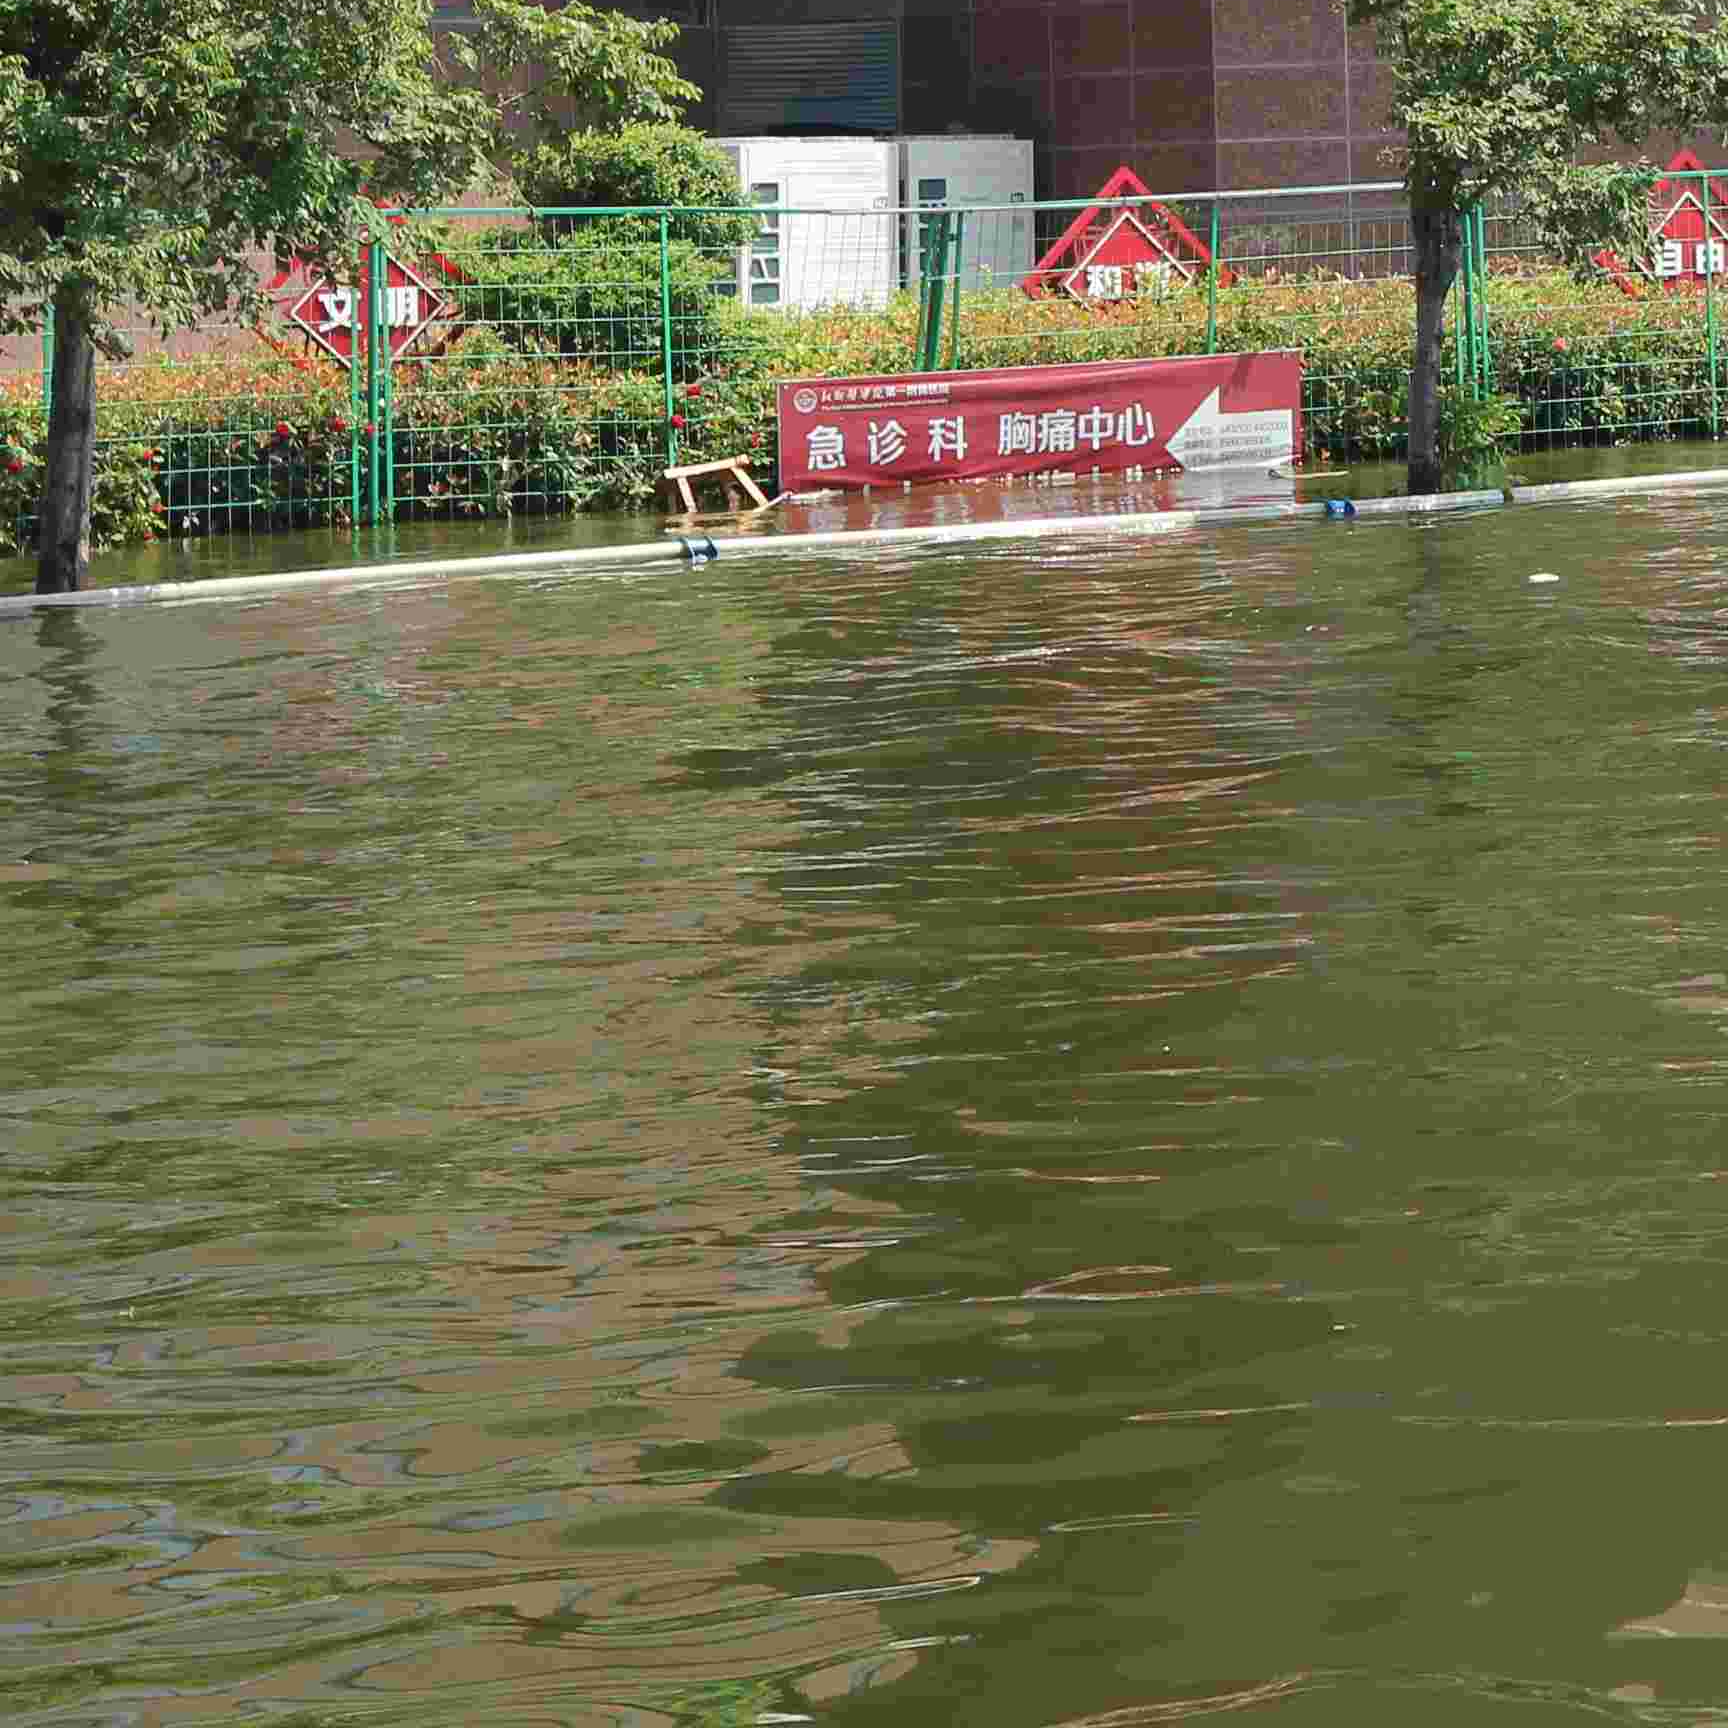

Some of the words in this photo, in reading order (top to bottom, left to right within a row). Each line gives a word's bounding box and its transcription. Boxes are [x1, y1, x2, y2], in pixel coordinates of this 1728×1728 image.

[1655, 239, 1725, 276] 自由
[805, 415, 968, 471] 急诊科
[997, 403, 1155, 456] 胸痛中心
